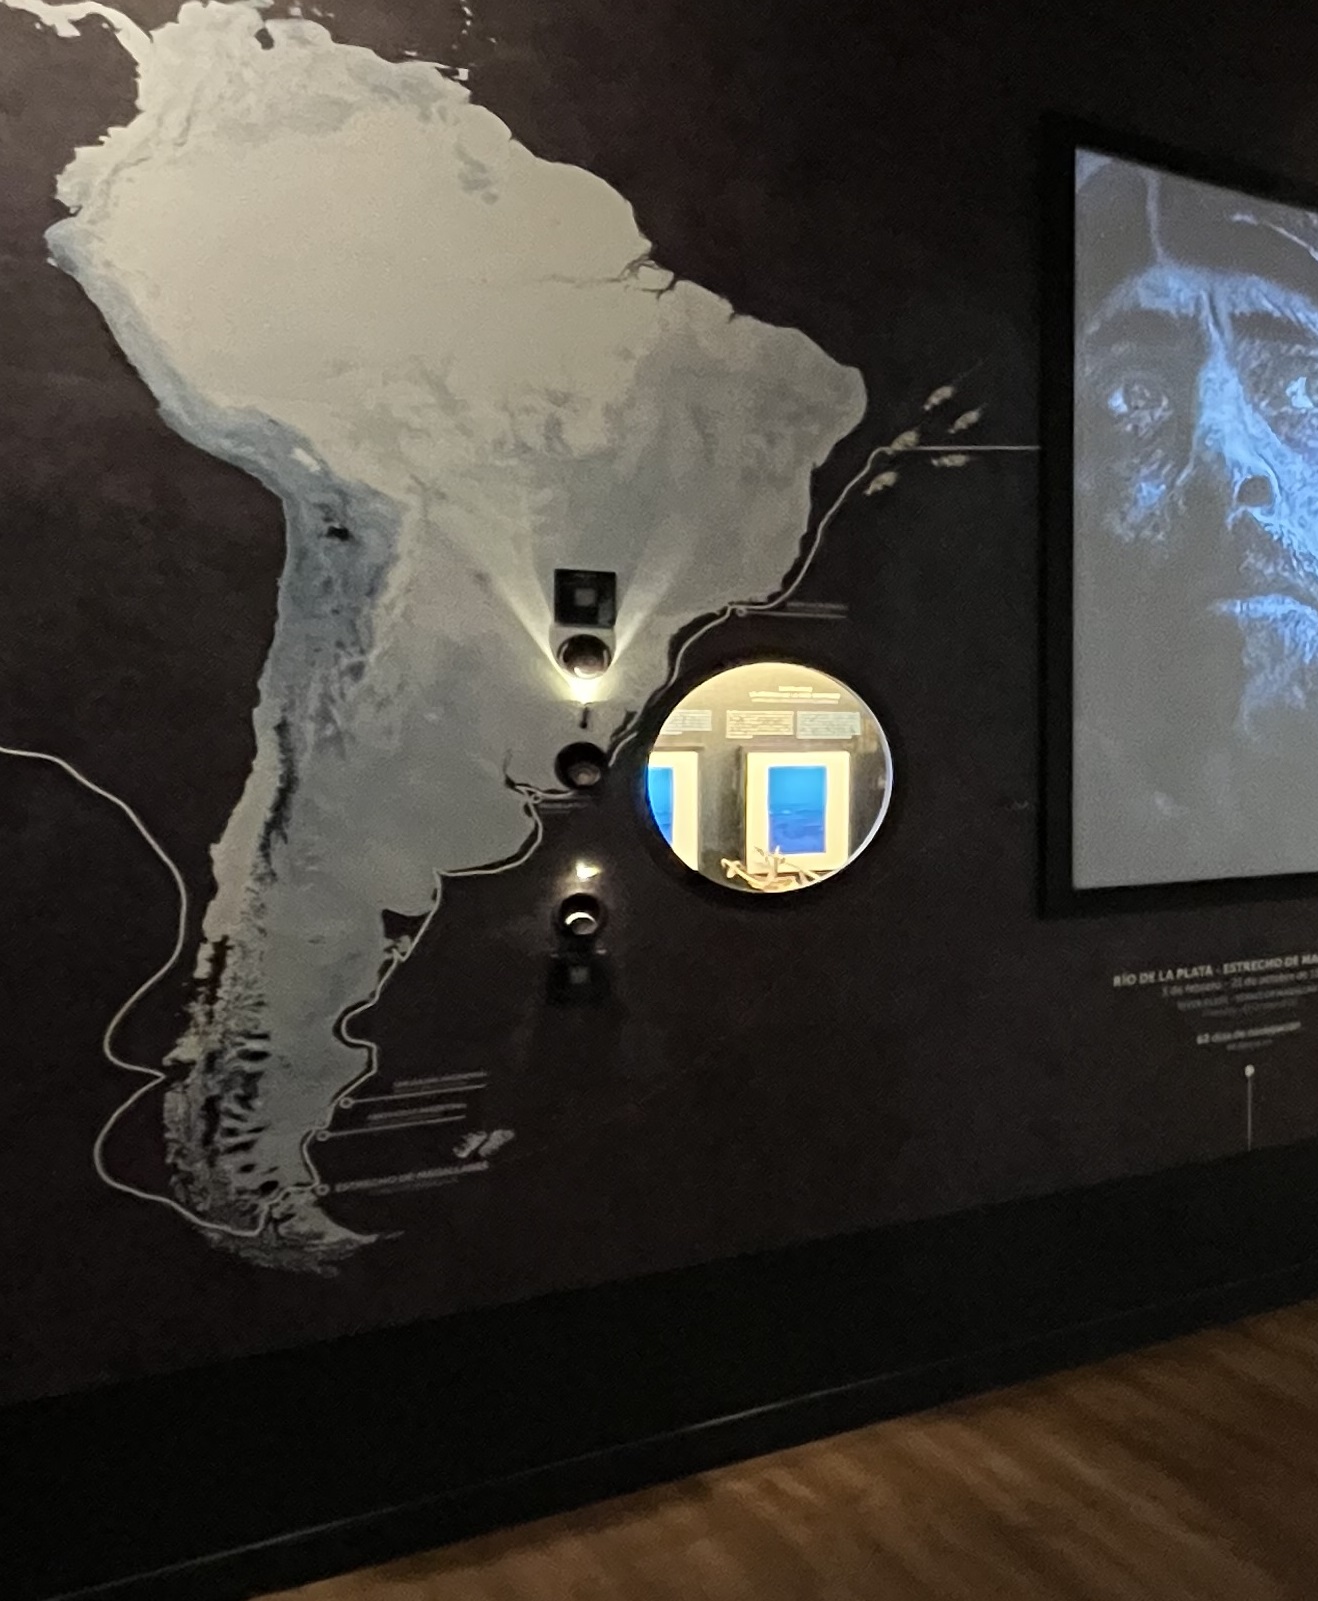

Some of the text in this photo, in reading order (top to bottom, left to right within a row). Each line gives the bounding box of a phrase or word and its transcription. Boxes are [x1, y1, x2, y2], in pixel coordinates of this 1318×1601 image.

[1139, 970, 1156, 984] DE
[1158, 968, 1174, 982] LA
[1176, 965, 1213, 980] PLATA
[1223, 957, 1283, 975] ESTRECHO
[1284, 955, 1299, 967] DE
